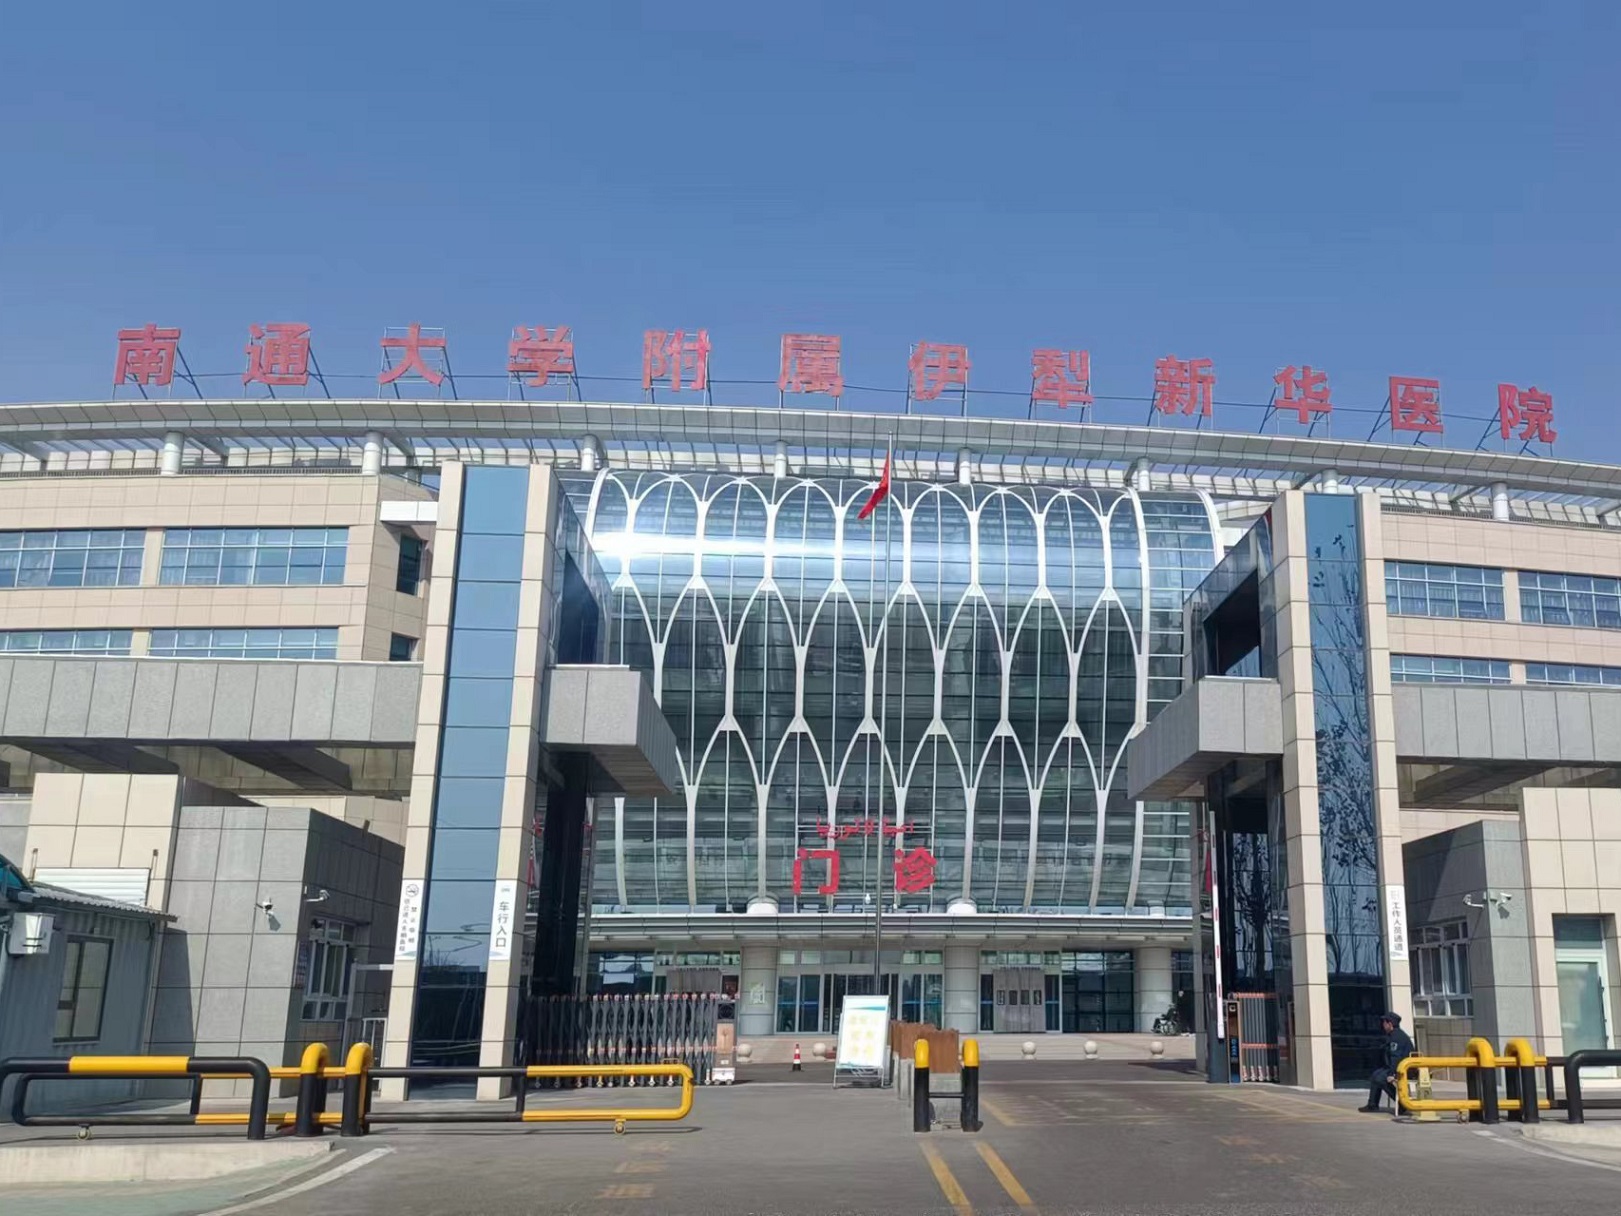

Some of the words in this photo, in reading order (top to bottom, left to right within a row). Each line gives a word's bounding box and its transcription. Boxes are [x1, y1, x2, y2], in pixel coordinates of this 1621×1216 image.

[114, 322, 1556, 443] 南通大学附属伊犁新华医院
[792, 846, 938, 895] 门诊
[495, 901, 510, 948] 车行入口
[1391, 902, 1404, 951] 工作人员通道
